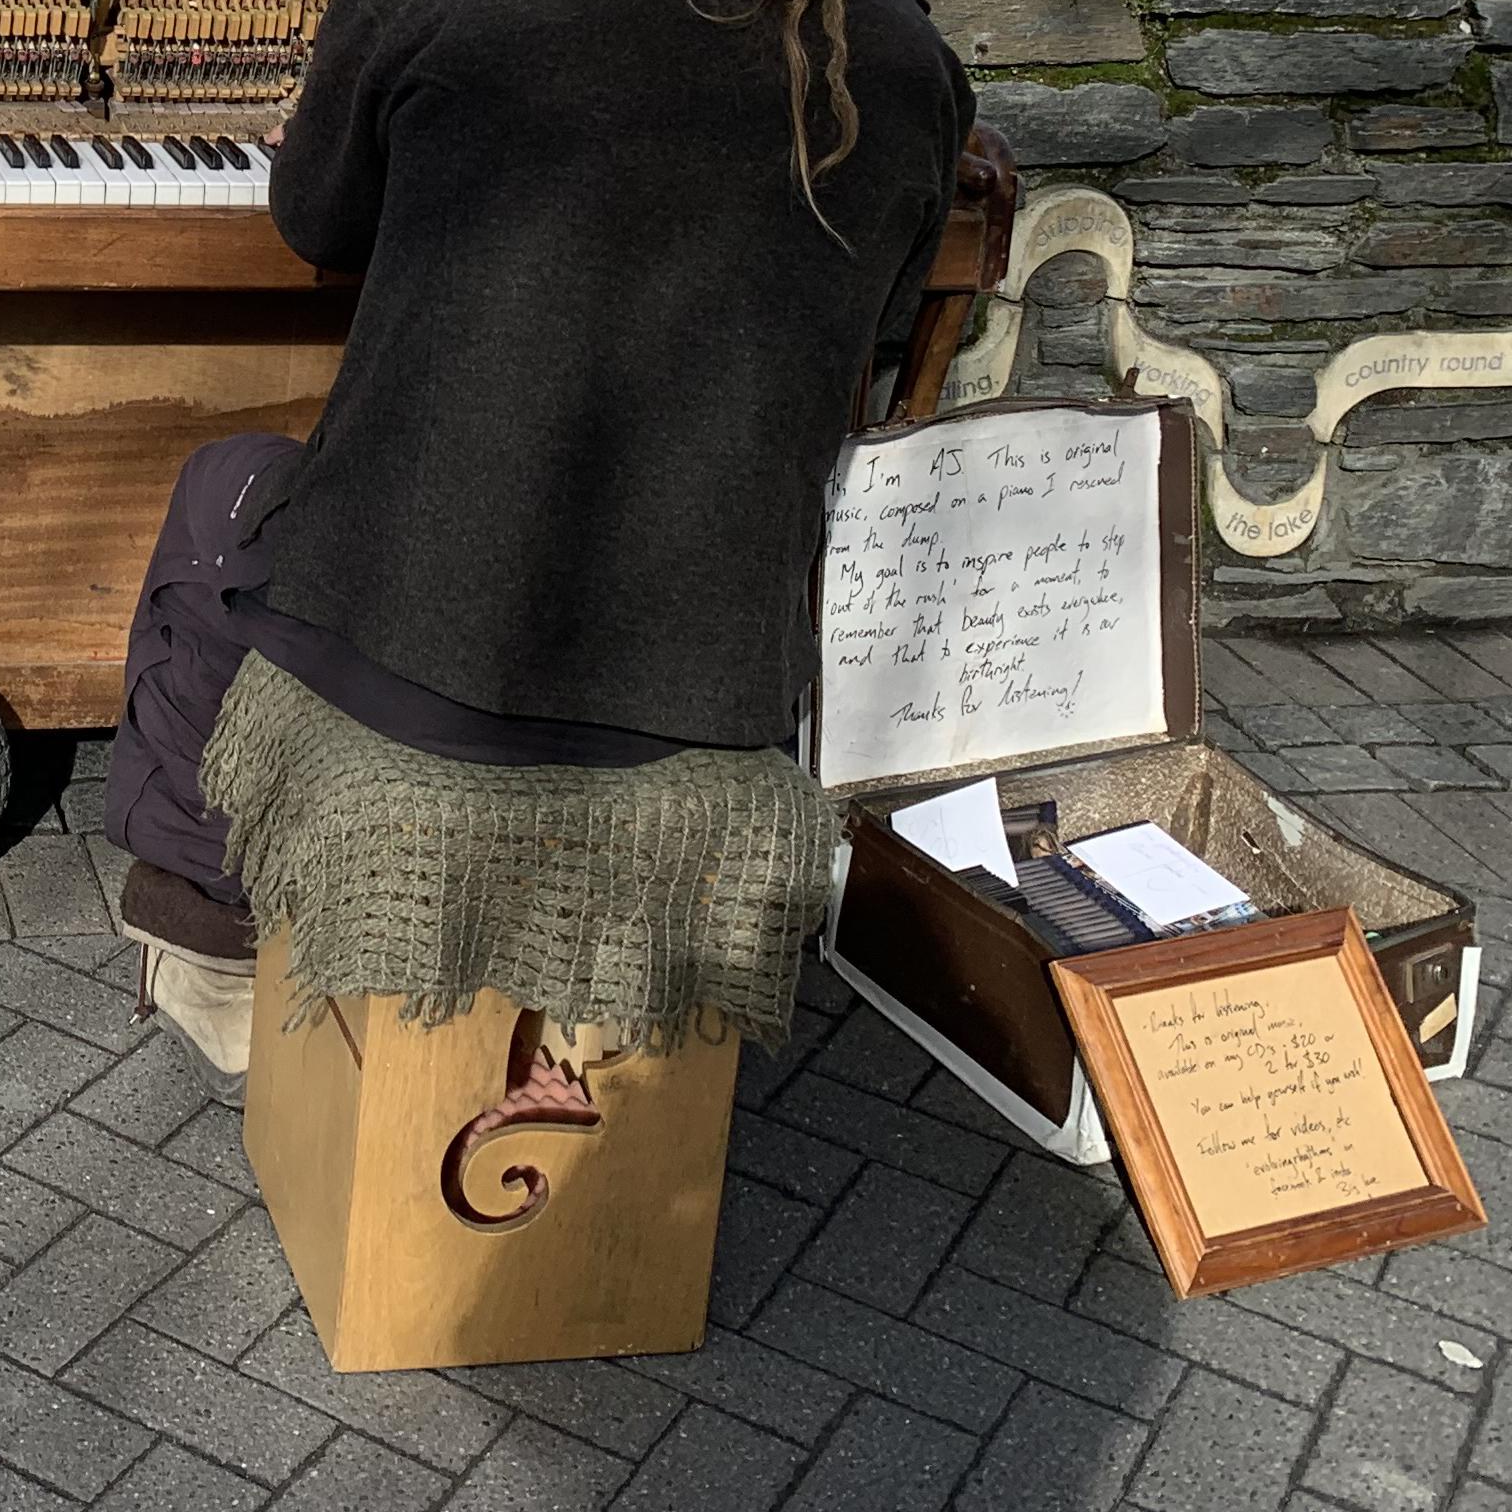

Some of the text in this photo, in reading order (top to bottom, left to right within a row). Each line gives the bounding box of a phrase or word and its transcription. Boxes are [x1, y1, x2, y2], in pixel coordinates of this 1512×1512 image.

[1131, 355, 1215, 408] working
[1344, 351, 1504, 388] country round
[865, 455, 901, 493] I'm
[988, 444, 1025, 469] This
[1040, 447, 1051, 463] is
[1065, 429, 1119, 467] original
[880, 492, 940, 526] composed
[950, 498, 967, 509] on
[977, 494, 987, 503] a
[998, 484, 1034, 510] piano
[1041, 473, 1056, 497] I
[1070, 462, 1126, 489] rescued
[864, 523, 883, 552] the
[1225, 507, 1314, 541] the lake
[841, 525, 1126, 597] My goal is to inspire people to step
[864, 592, 877, 615] of
[885, 586, 907, 609] the
[974, 577, 995, 598] for
[1098, 565, 1110, 582] to
[830, 617, 898, 643] remember
[913, 611, 943, 636] that
[962, 605, 1005, 634] beauty
[1017, 600, 1051, 618] exists
[838, 642, 873, 666] and
[891, 641, 925, 664] that
[941, 640, 951, 660] to
[965, 634, 1041, 659] experience
[1053, 627, 1068, 643] it
[890, 691, 945, 728] Thanks
[961, 685, 982, 717] for
[1168, 1033, 1197, 1052] This
[1290, 1033, 1316, 1049] $20
[1265, 1049, 1330, 1075] 2 for $30
[1190, 1098, 1211, 1116] You
[1240, 1085, 1261, 1110] help
[1197, 1130, 1236, 1156] Follow
